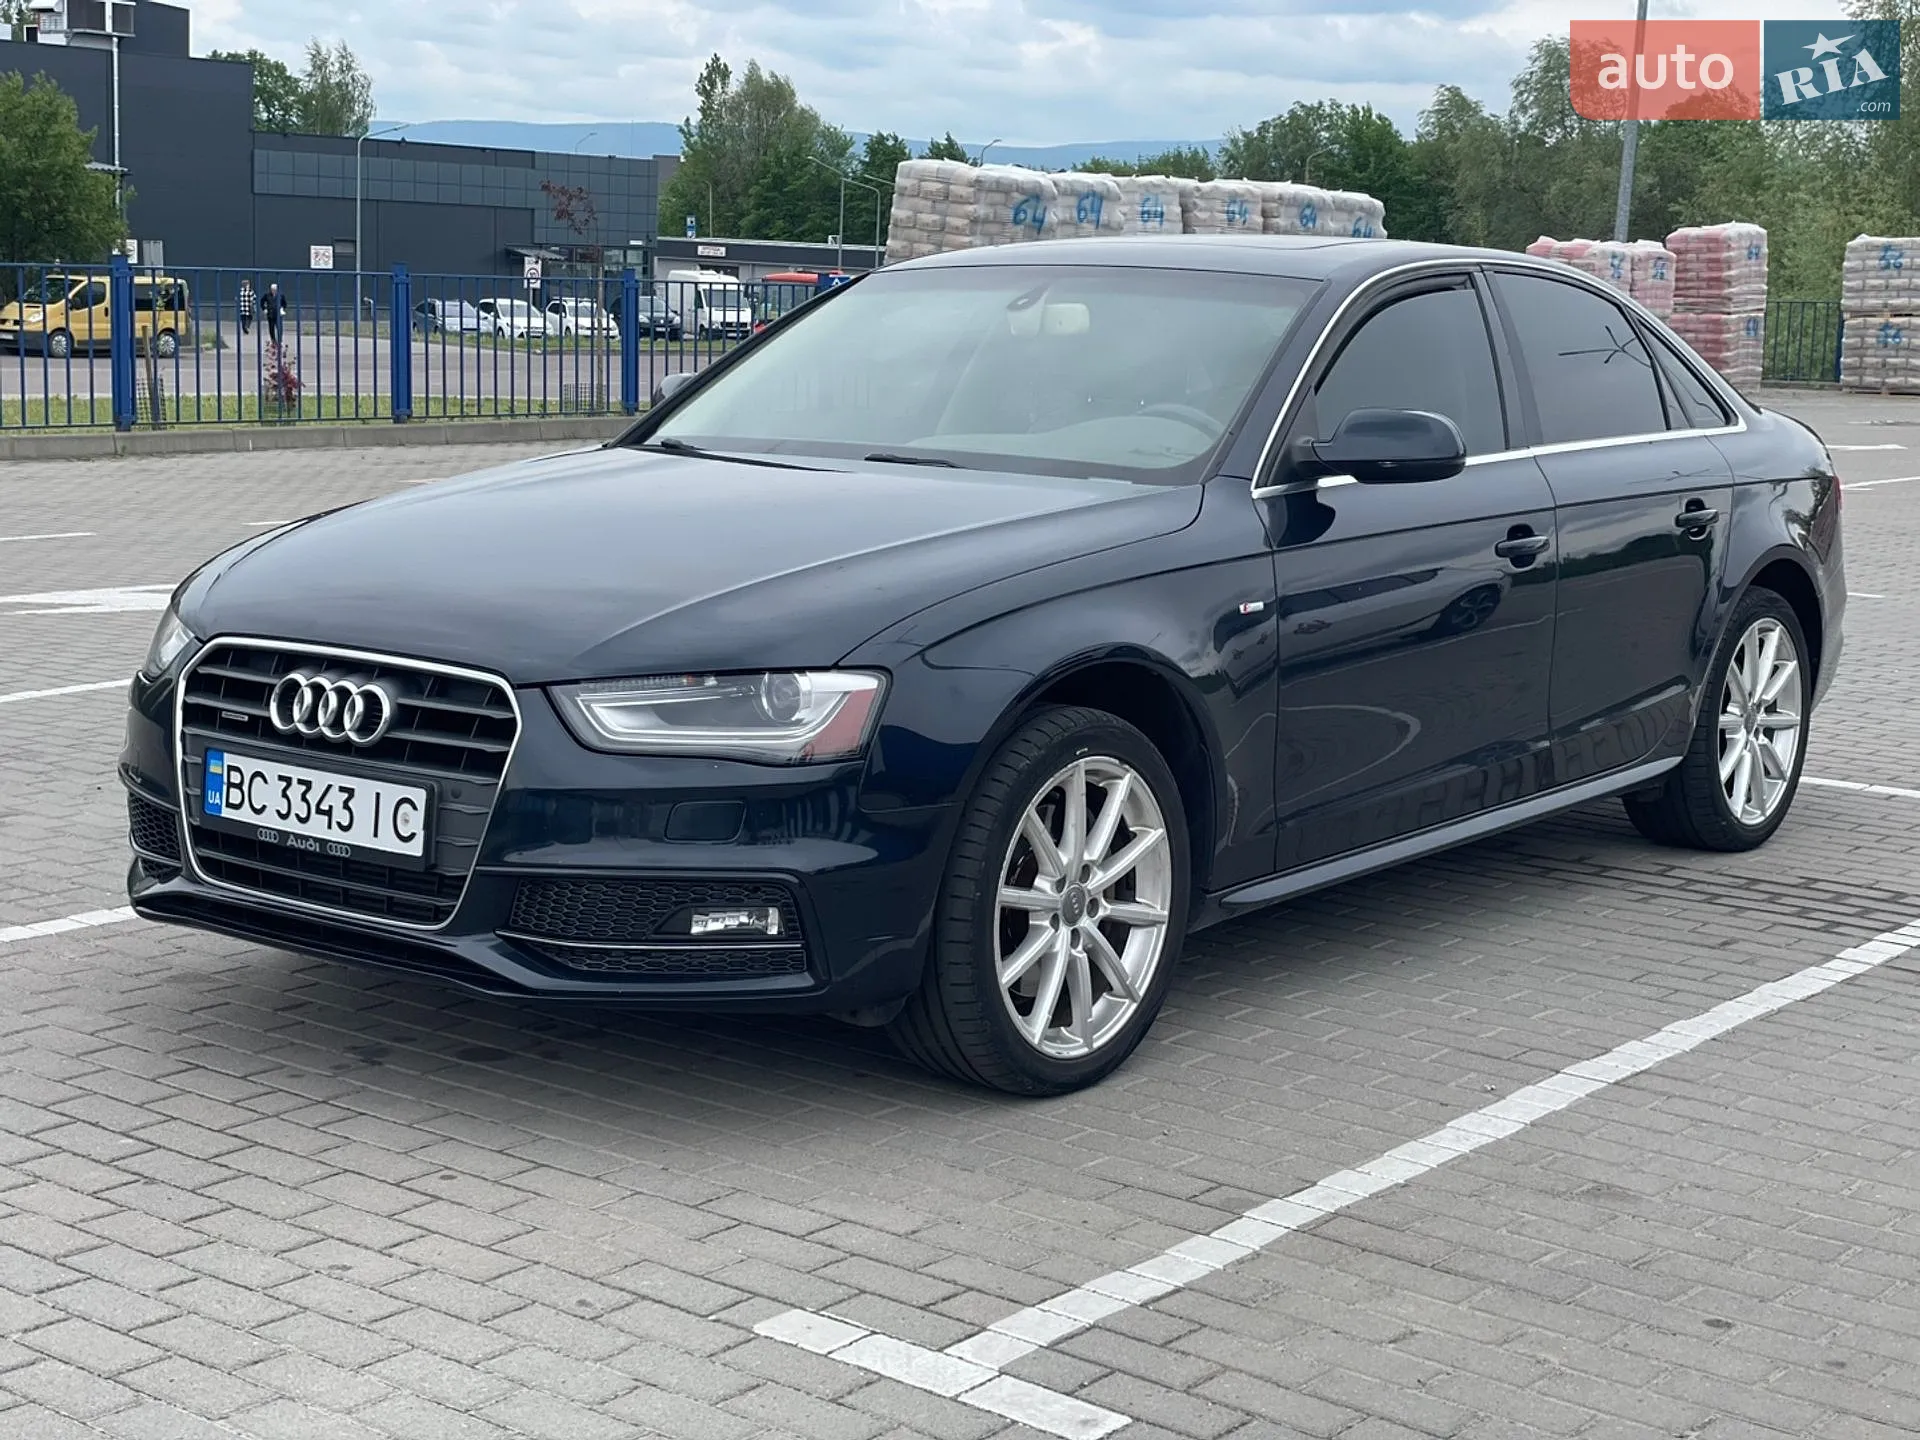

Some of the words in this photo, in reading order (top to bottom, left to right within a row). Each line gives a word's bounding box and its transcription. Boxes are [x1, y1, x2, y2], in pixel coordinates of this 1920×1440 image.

[1012, 194, 1047, 235] 64
[1141, 193, 1164, 225] 64
[1226, 196, 1249, 225] 64
[1300, 201, 1317, 229] 64
[208, 790, 221, 806] UA
[225, 764, 268, 815] BC
[275, 774, 355, 832] 3343
[373, 792, 418, 843] IC
[286, 834, 320, 852] Audi
